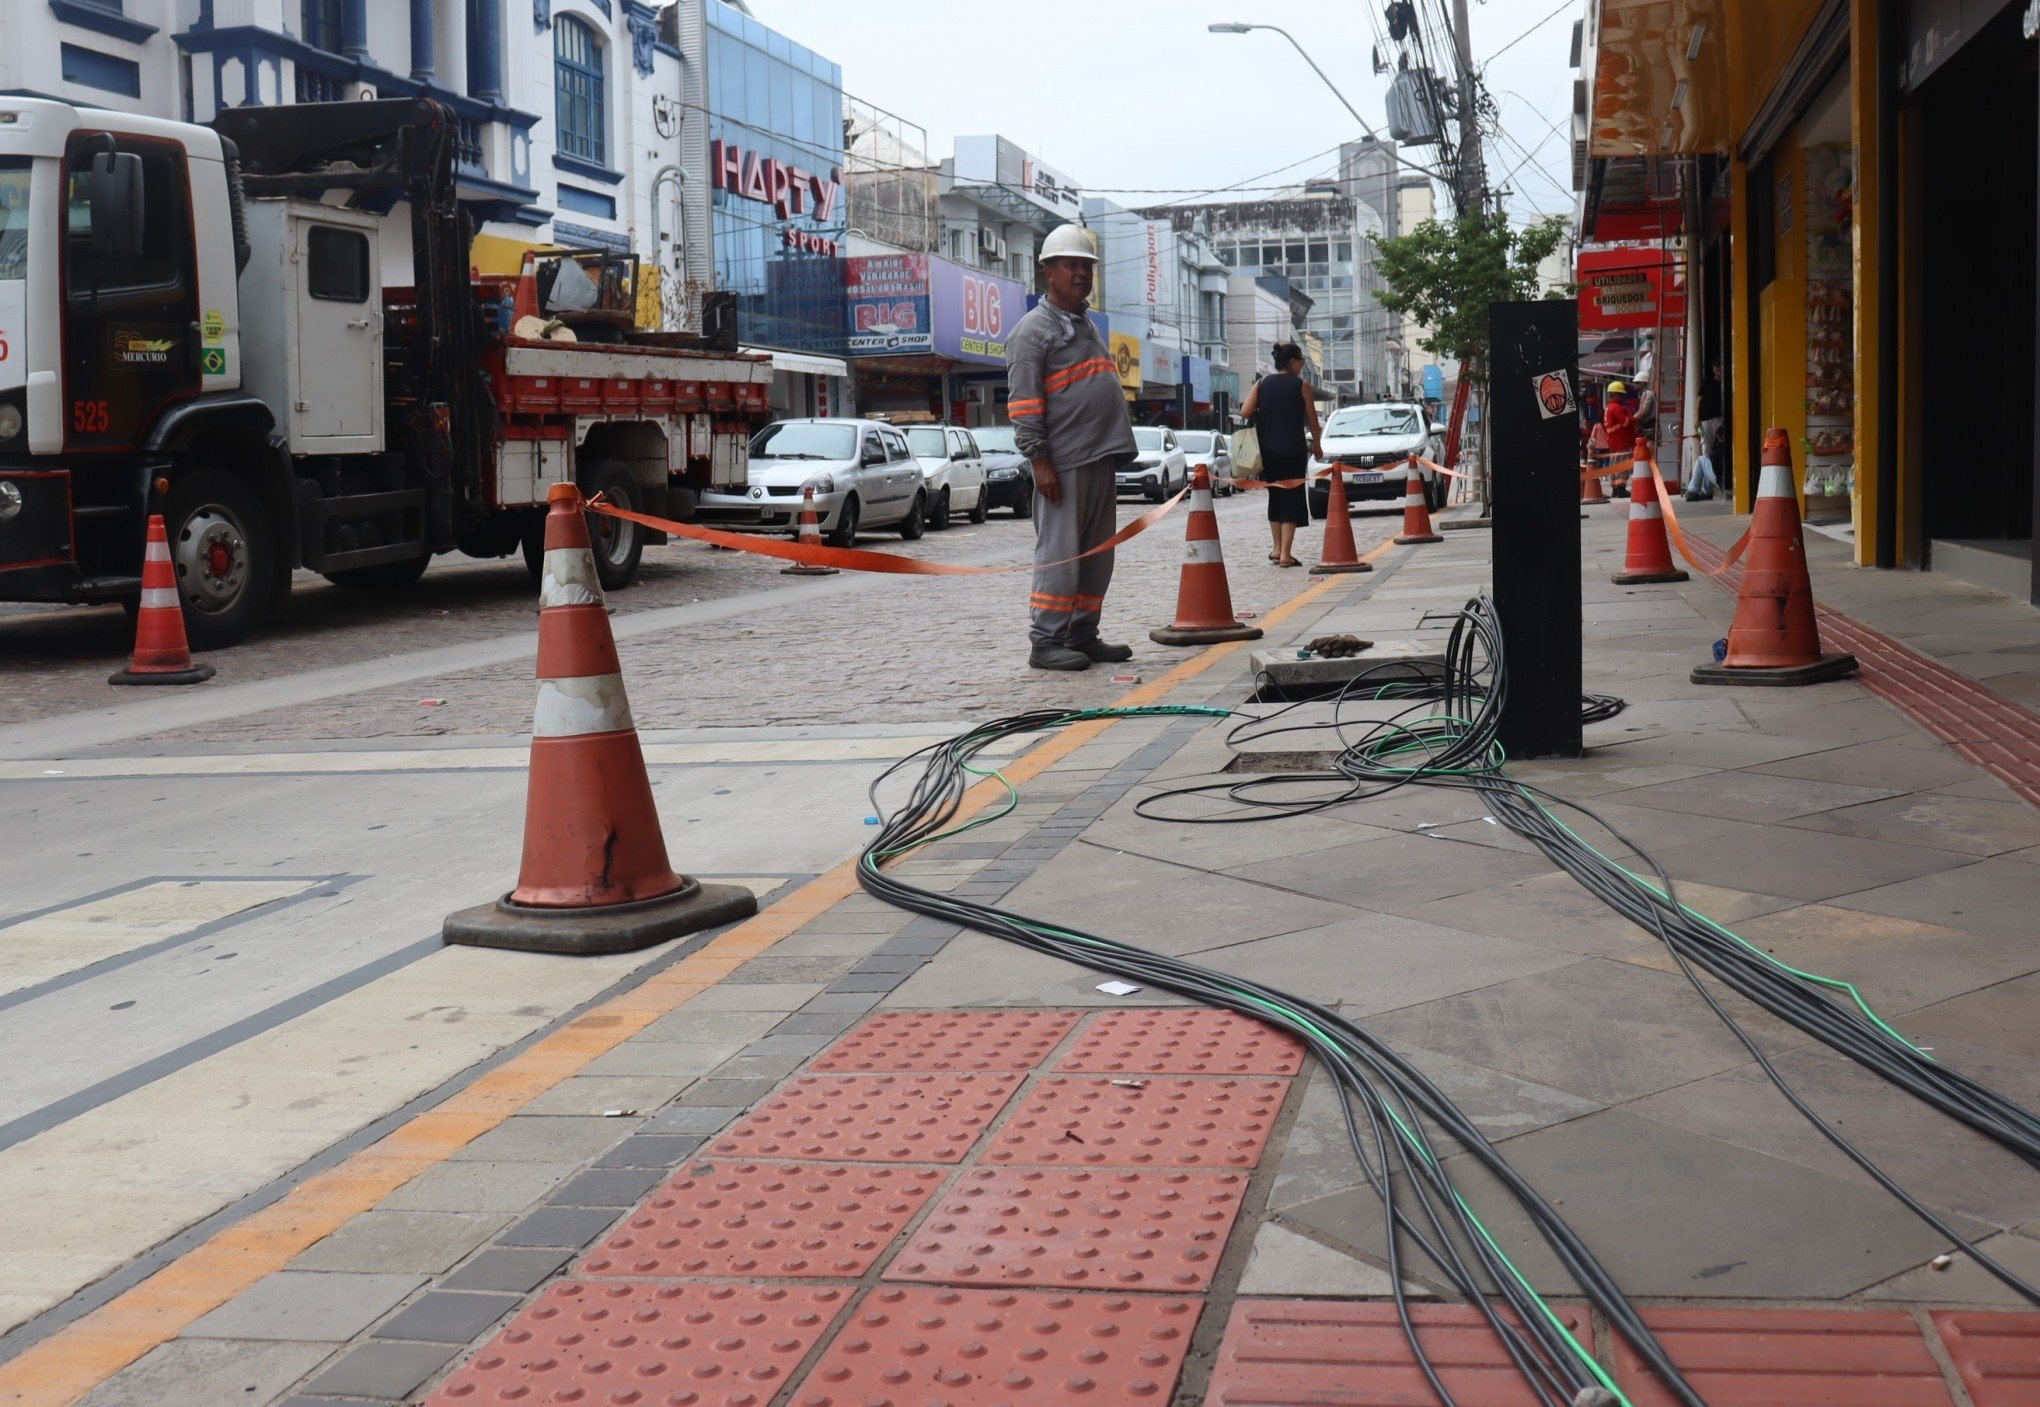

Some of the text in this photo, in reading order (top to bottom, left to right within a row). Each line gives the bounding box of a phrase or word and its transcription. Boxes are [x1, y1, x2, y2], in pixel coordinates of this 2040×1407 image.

[711, 140, 837, 222] HARTY
[784, 228, 840, 258] SPORT
[1594, 273, 1644, 286] UTILIDADES
[855, 302, 916, 332] BIG
[963, 275, 1002, 338] BIG
[1615, 303, 1644, 313] DOCES
[962, 339, 985, 353] CENTER
[74, 401, 109, 431] 525
[1361, 456, 1374, 466] FIAT
